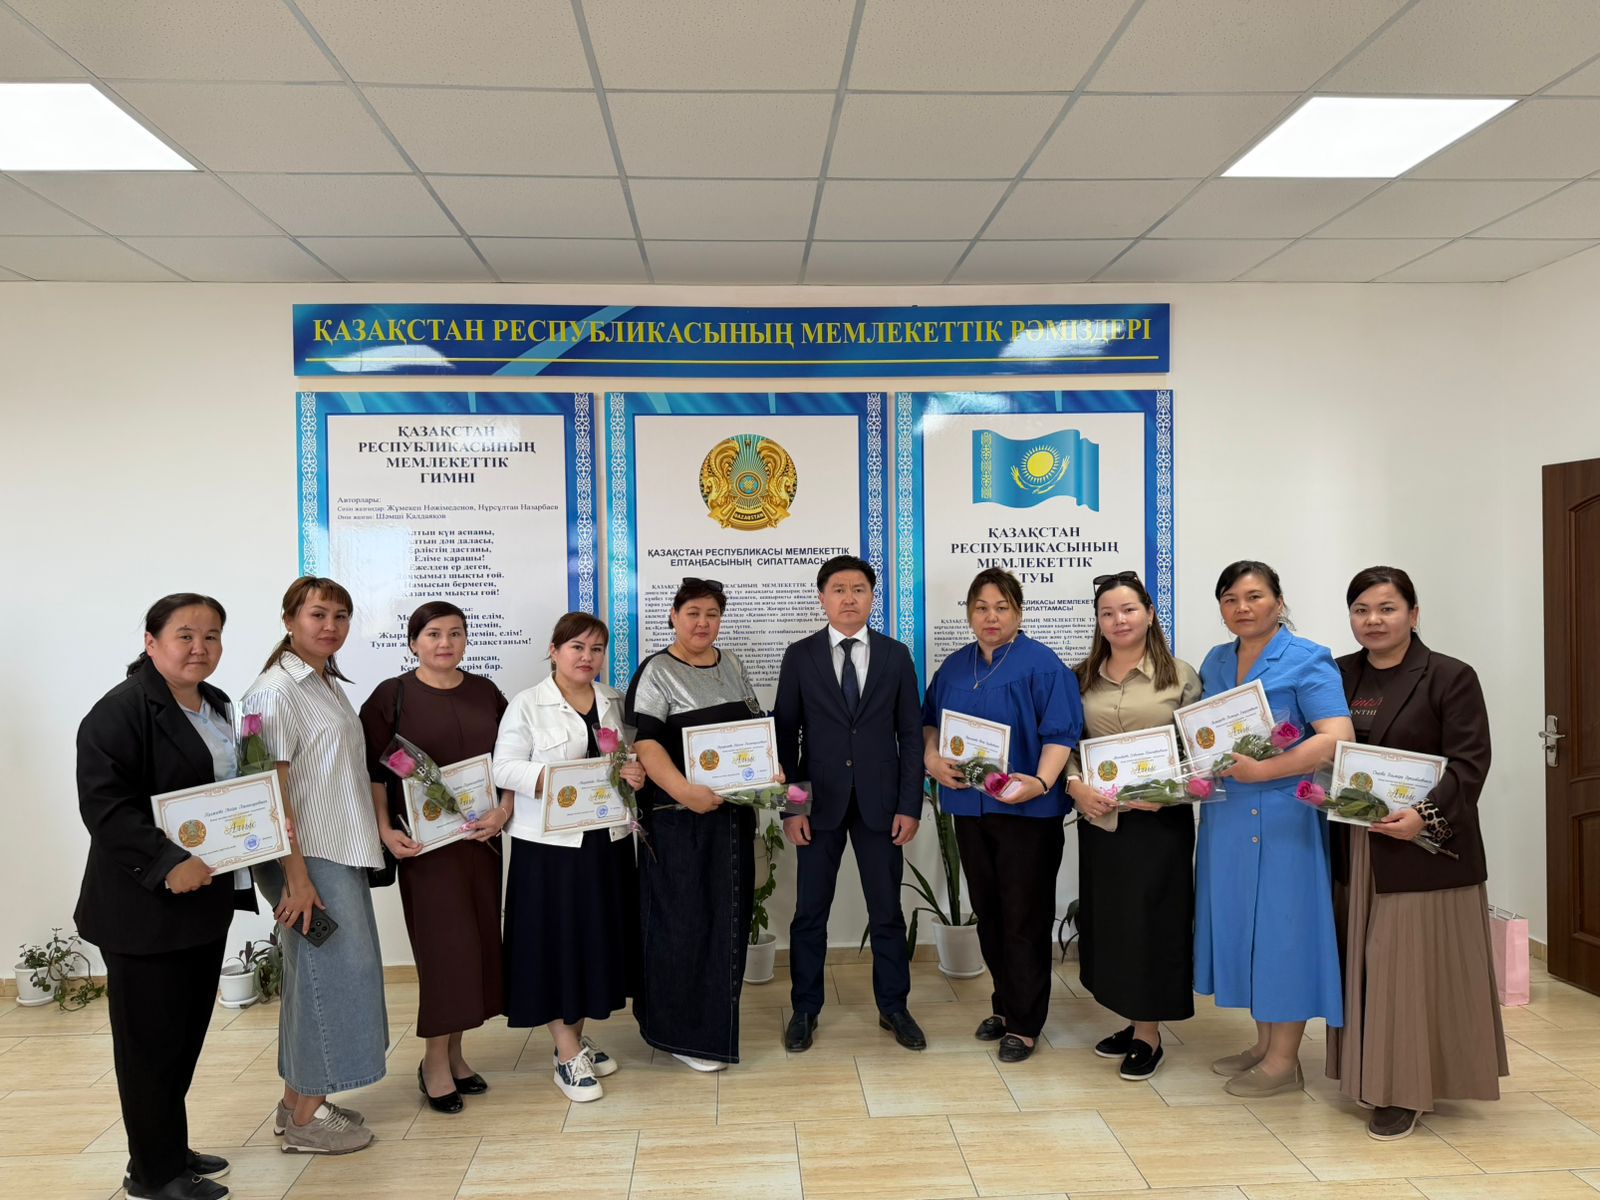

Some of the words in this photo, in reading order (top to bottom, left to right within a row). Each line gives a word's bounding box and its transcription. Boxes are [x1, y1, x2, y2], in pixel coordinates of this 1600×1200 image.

[313, 318, 484, 346] ҚАЗАҚСТАН
[493, 319, 795, 349] РЕСПУБЛИКАСЫНЫҢ
[801, 320, 1004, 344] МЕМЛЕКЕТТІК
[1009, 318, 1152, 344] РӘМІЗДЕРІ
[398, 426, 495, 438] ҚАЗАҚСТАН
[358, 441, 536, 454] РЕСПУБЛИКАСЫНЫҢ
[386, 458, 508, 468] МЕМЛЕКЕТТІК
[420, 472, 476, 484] ГИМНІ
[520, 504, 559, 512] Назарбаев
[988, 527, 1080, 539] ҚАЗАҚСТАН
[648, 549, 702, 558] ҚАЗАҚСТАН
[706, 548, 784, 556] РЕСПУБЛИКАСЫ
[951, 542, 1120, 554] РЕСПУБЛИКАСЫНЫҢ
[670, 558, 752, 568] ЕЛТАҢБАСЫНЫҢ
[977, 557, 1093, 568] МЕМЛЕКЕТТІК
[1019, 572, 1054, 583] ТУЫ
[370, 642, 398, 650] Туған
[466, 638, 532, 647] Қазақстаным!
